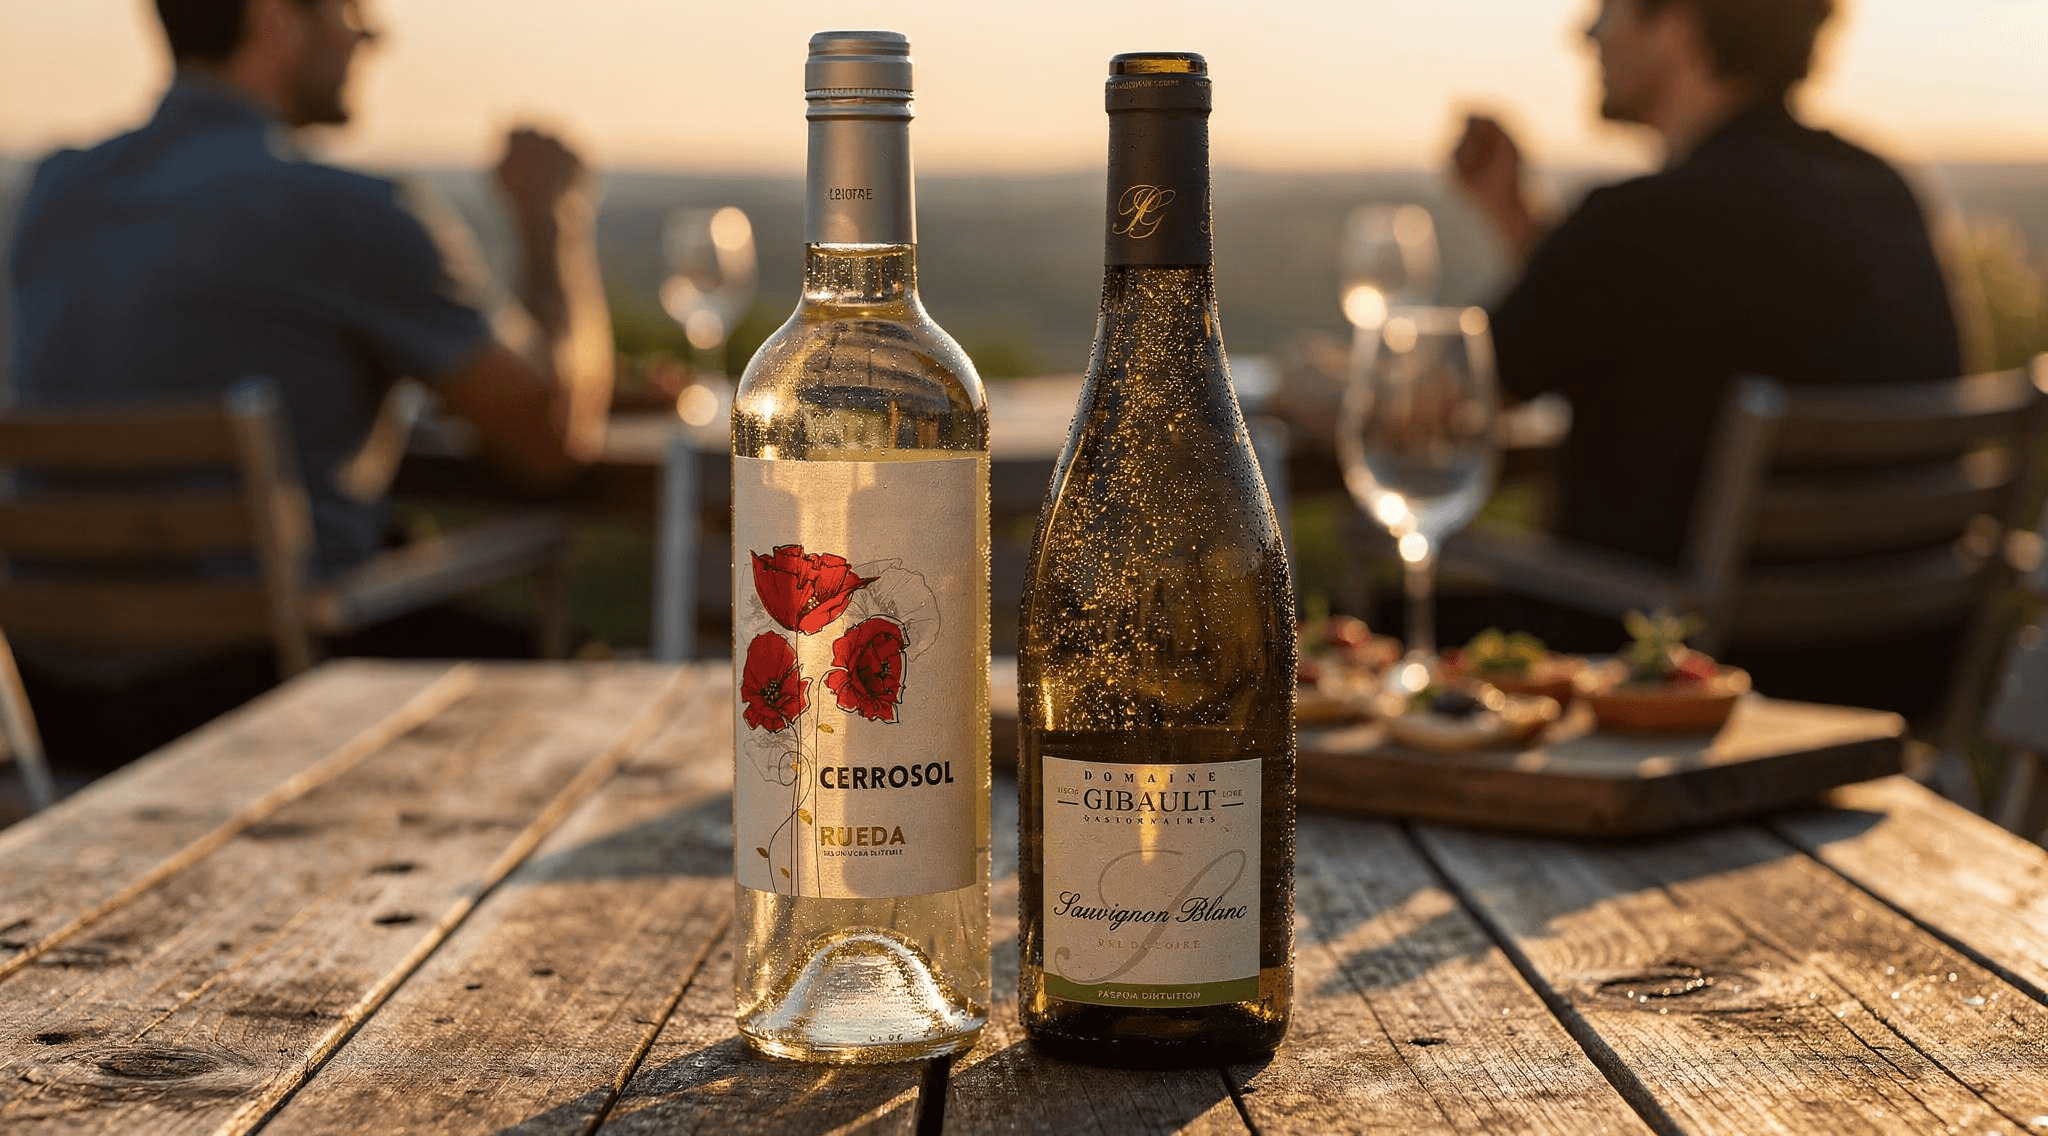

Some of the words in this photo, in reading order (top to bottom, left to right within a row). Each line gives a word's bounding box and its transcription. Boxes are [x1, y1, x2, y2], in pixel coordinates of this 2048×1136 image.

[819, 761, 955, 790] CERROSOL
[1083, 769, 1217, 783] DOMAINE
[1083, 788, 1218, 812] GIBAULT
[820, 825, 907, 847] RUEDA
[1053, 891, 1170, 931] Sauvignon
[1174, 896, 1249, 923] Blanc
